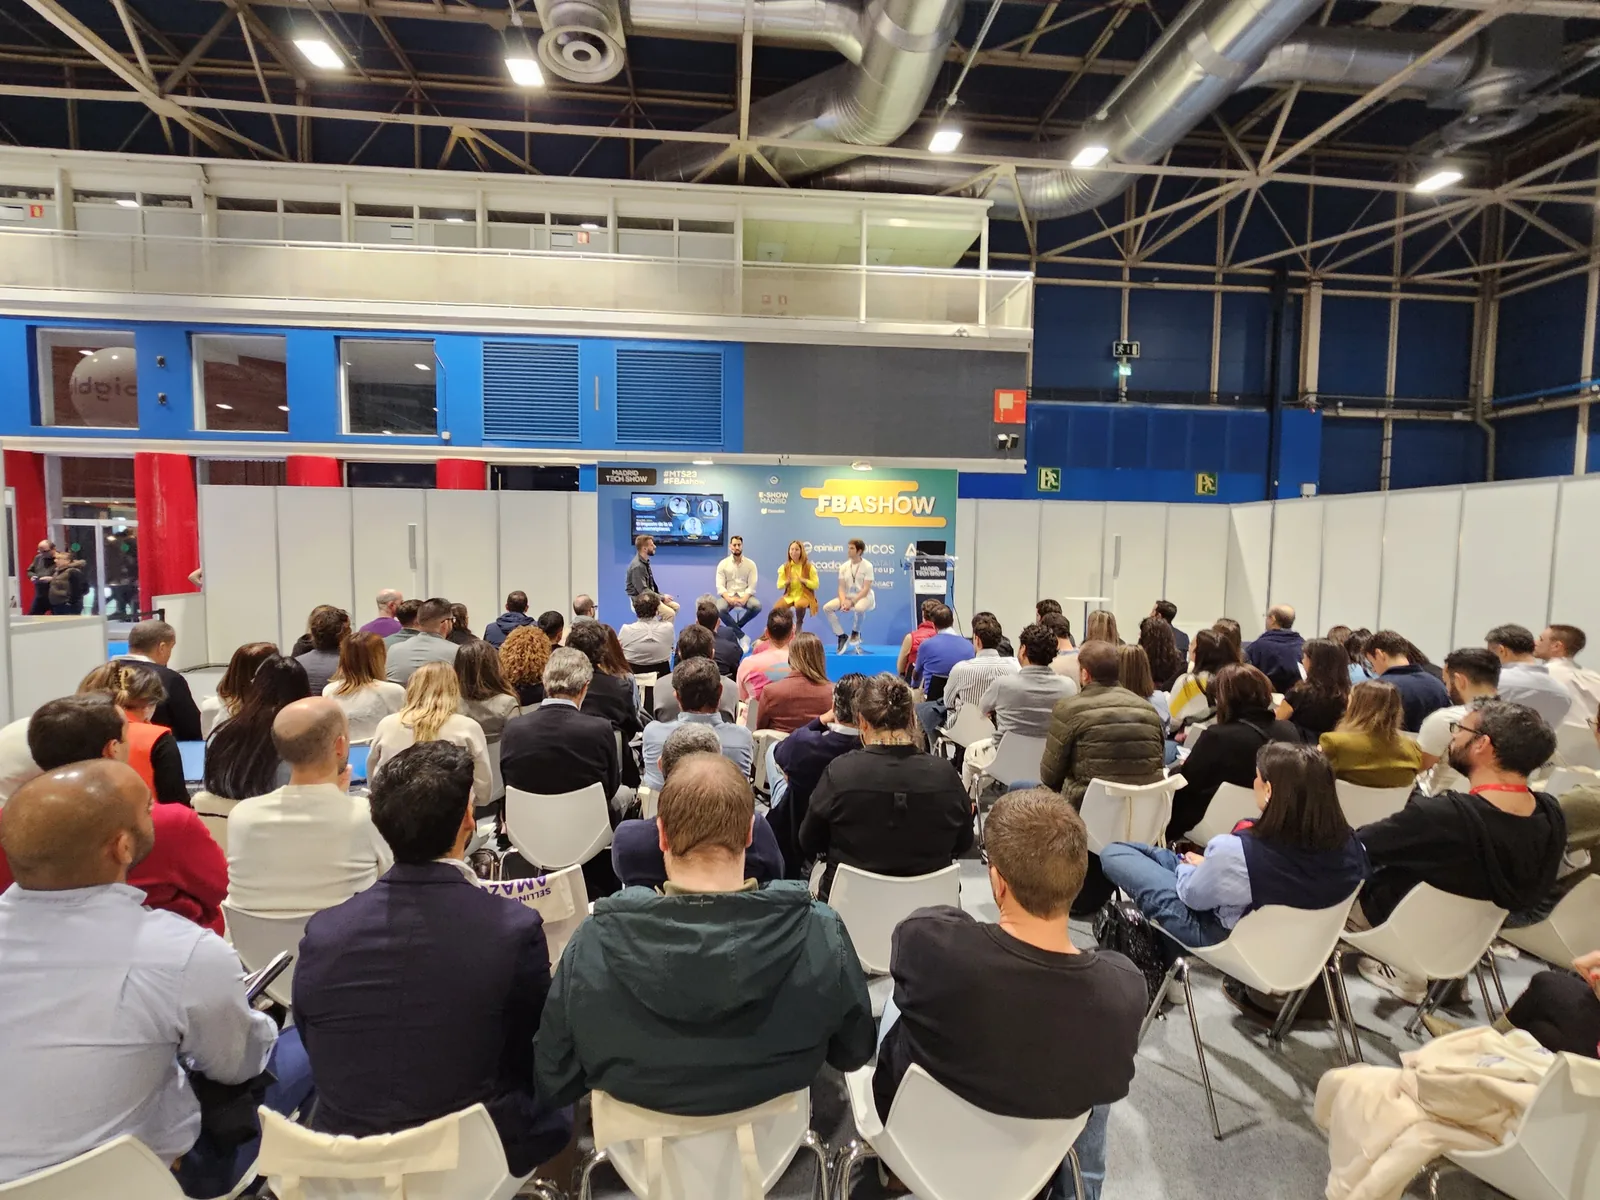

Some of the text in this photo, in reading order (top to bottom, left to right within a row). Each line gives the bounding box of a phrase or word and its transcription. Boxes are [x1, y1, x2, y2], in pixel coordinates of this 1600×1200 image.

[605, 475, 648, 483] TECH SHOW
[663, 470, 697, 478] #MTS23
[663, 477, 706, 485] #FBAshow
[818, 494, 936, 515] FBASHOW
[481, 875, 547, 896] AMAZ
[513, 887, 552, 903] SELLIN
